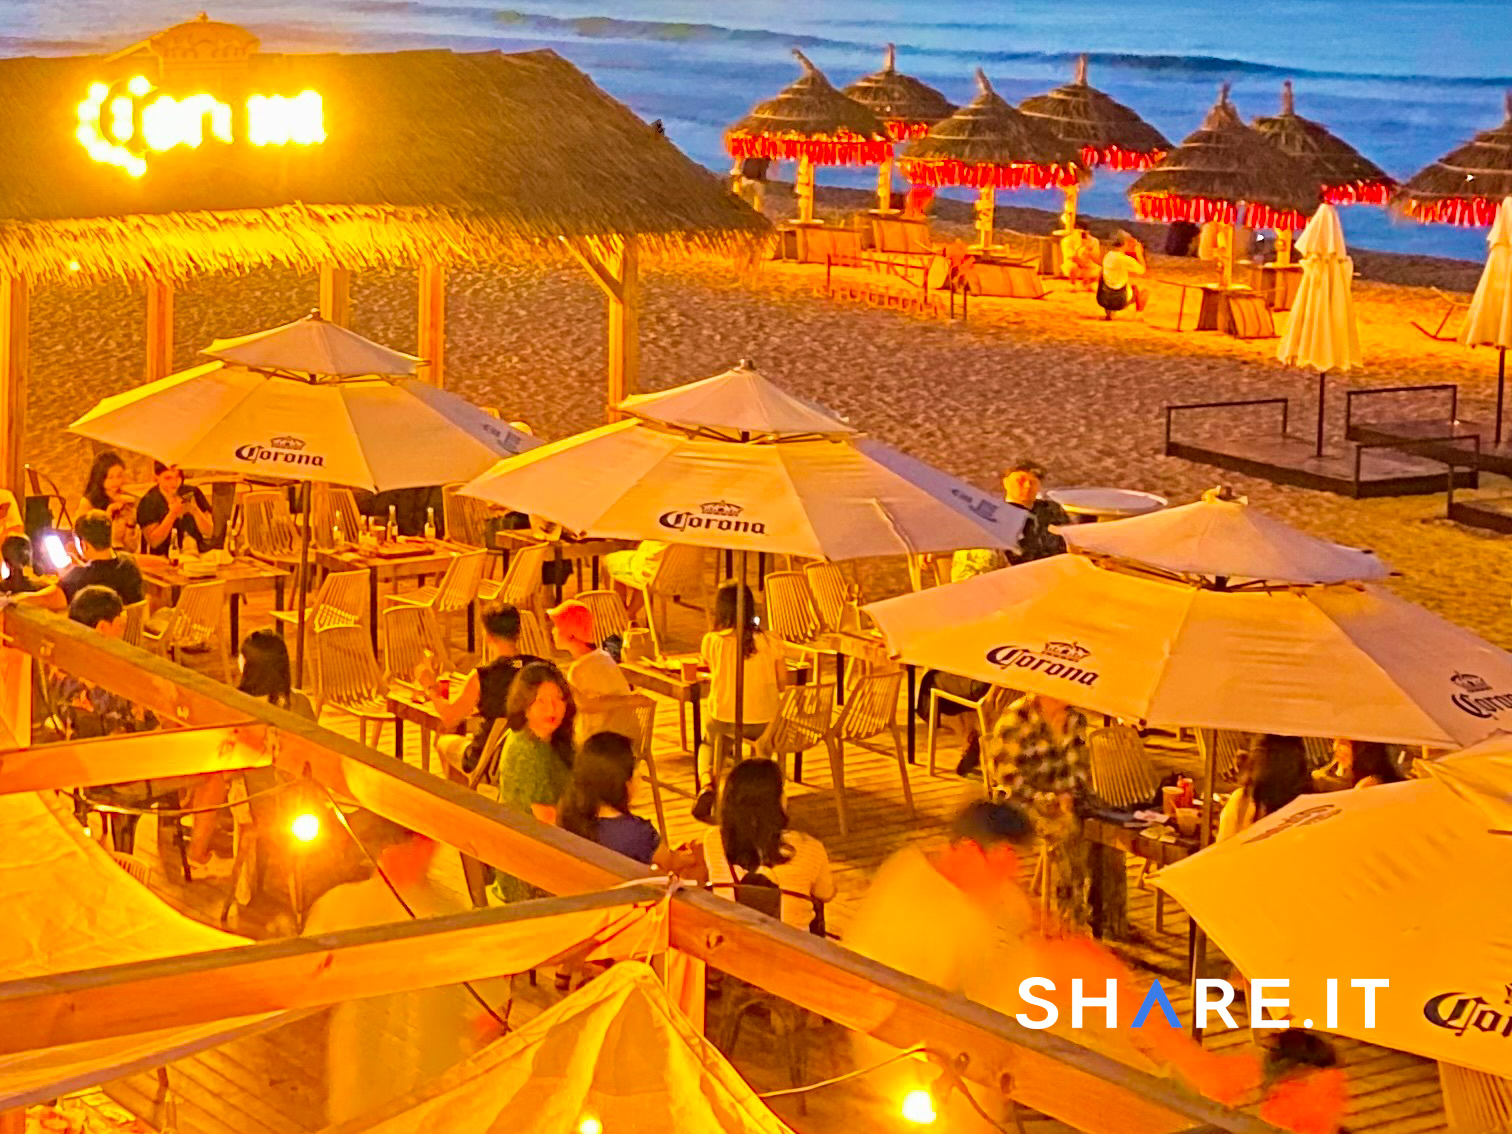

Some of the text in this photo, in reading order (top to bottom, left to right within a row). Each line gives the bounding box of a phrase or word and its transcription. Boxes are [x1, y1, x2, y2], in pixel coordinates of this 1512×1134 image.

[235, 444, 325, 467] Corona
[659, 510, 769, 533] Corona
[986, 645, 1100, 686] Corona
